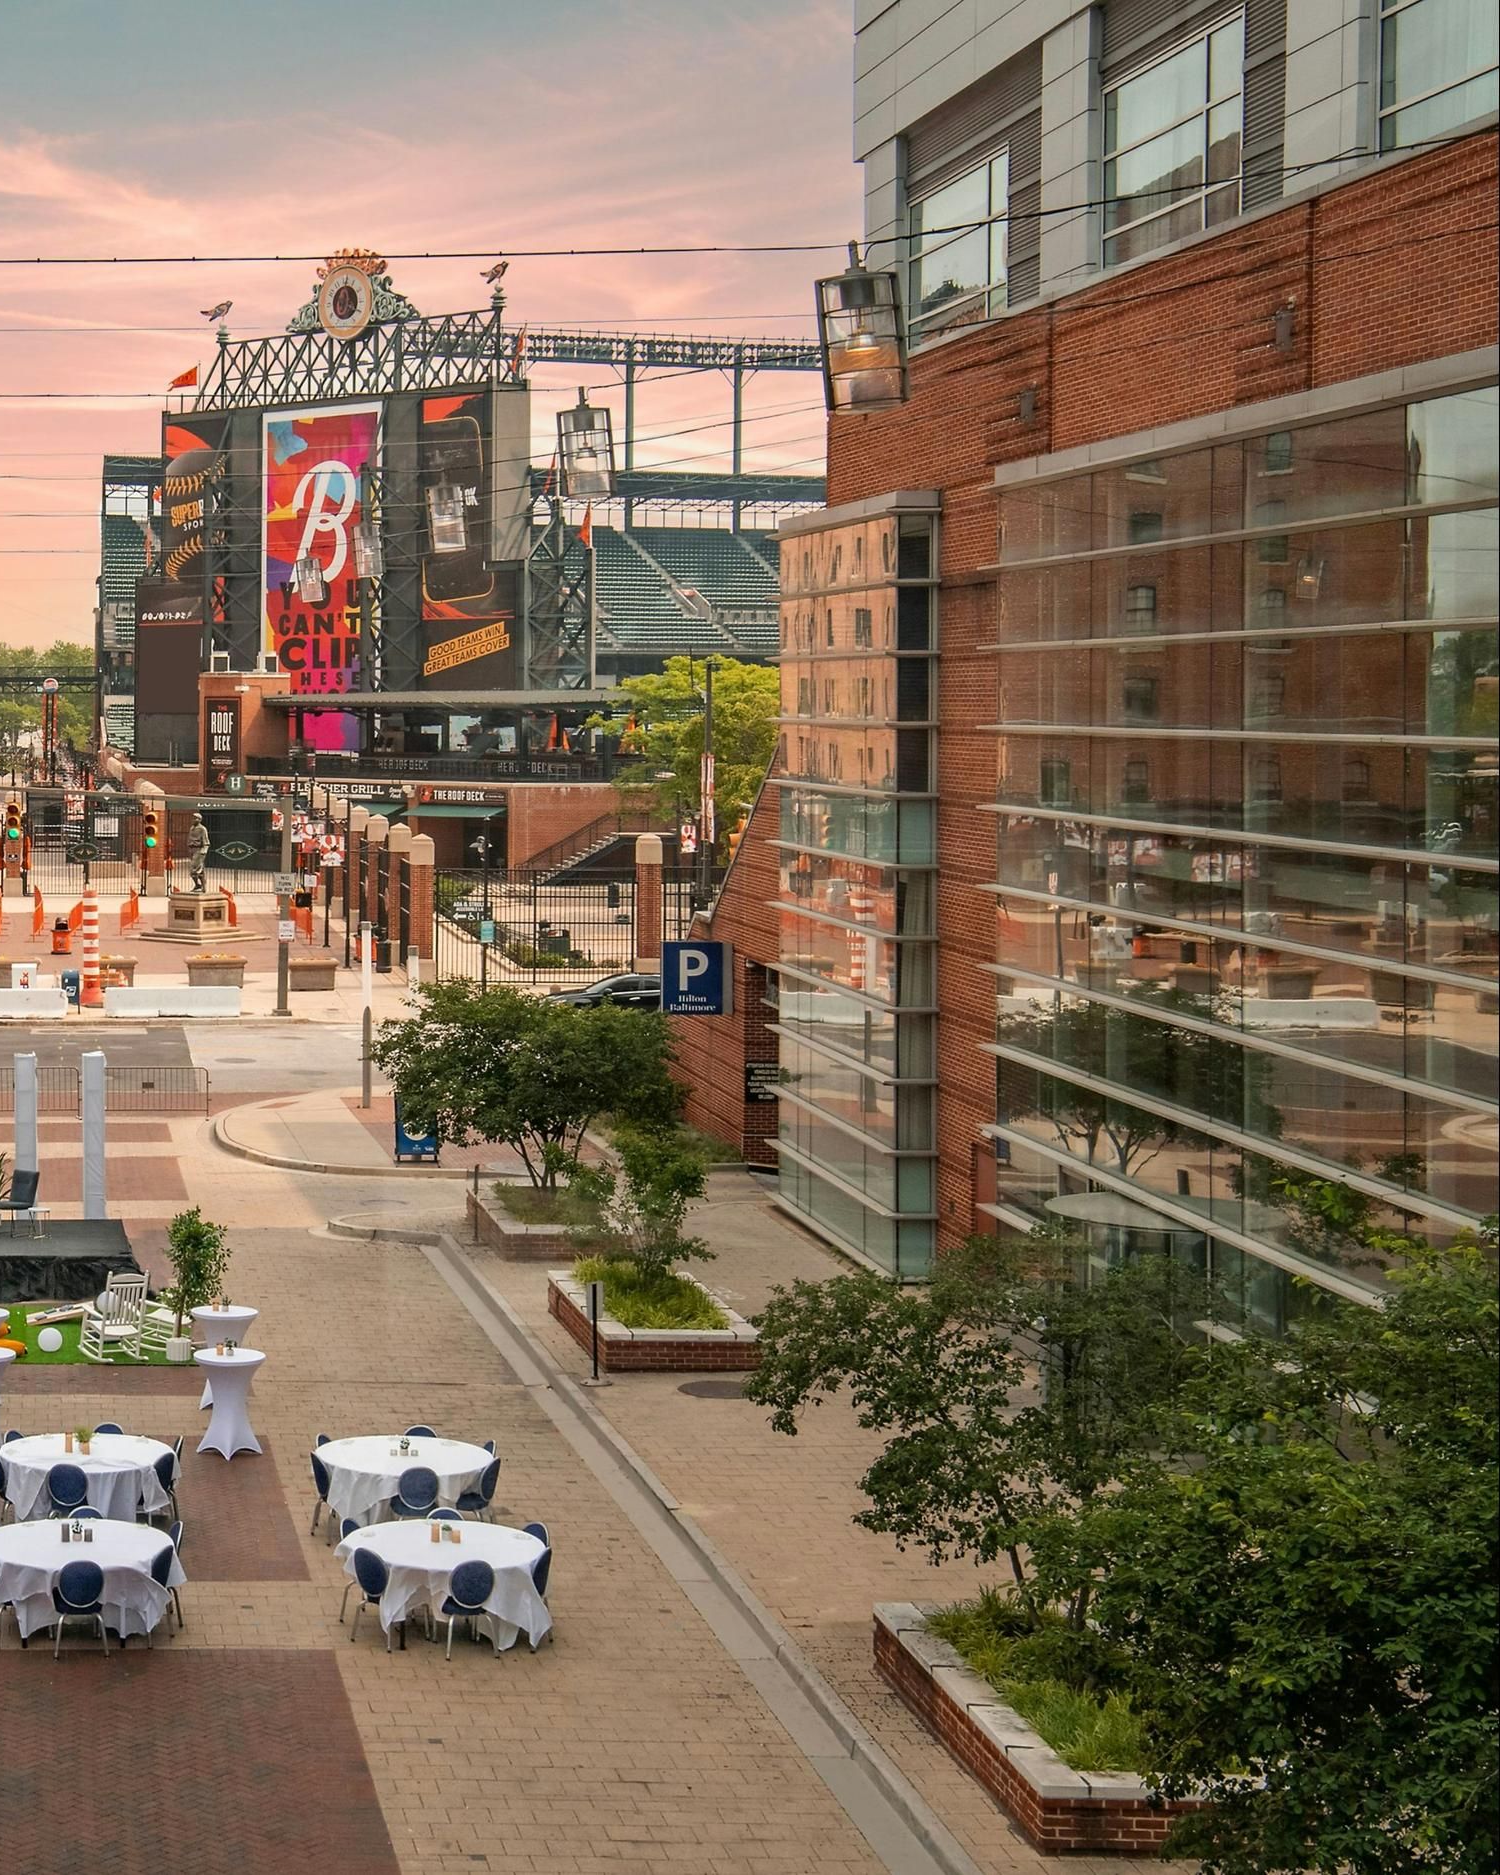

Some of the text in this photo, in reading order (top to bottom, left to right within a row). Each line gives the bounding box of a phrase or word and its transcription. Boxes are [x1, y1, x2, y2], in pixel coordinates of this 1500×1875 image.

[278, 612, 361, 635] CAN'T
[430, 642, 456, 658] GOOD
[457, 633, 483, 650] TEAMS
[425, 638, 508, 673] GREAT TEAMS COVER
[300, 672, 361, 686] HESE
[210, 712, 234, 734] ROOF
[213, 735, 231, 752] DECK
[230, 777, 241, 789] H
[351, 785, 384, 795] GRILL
[433, 789, 447, 800] THE
[448, 790, 465, 801] ROOF
[466, 791, 485, 802] DECK
[679, 949, 709, 991] P
[678, 994, 707, 1003] Hilton
[669, 1003, 716, 1012] Baltimore
